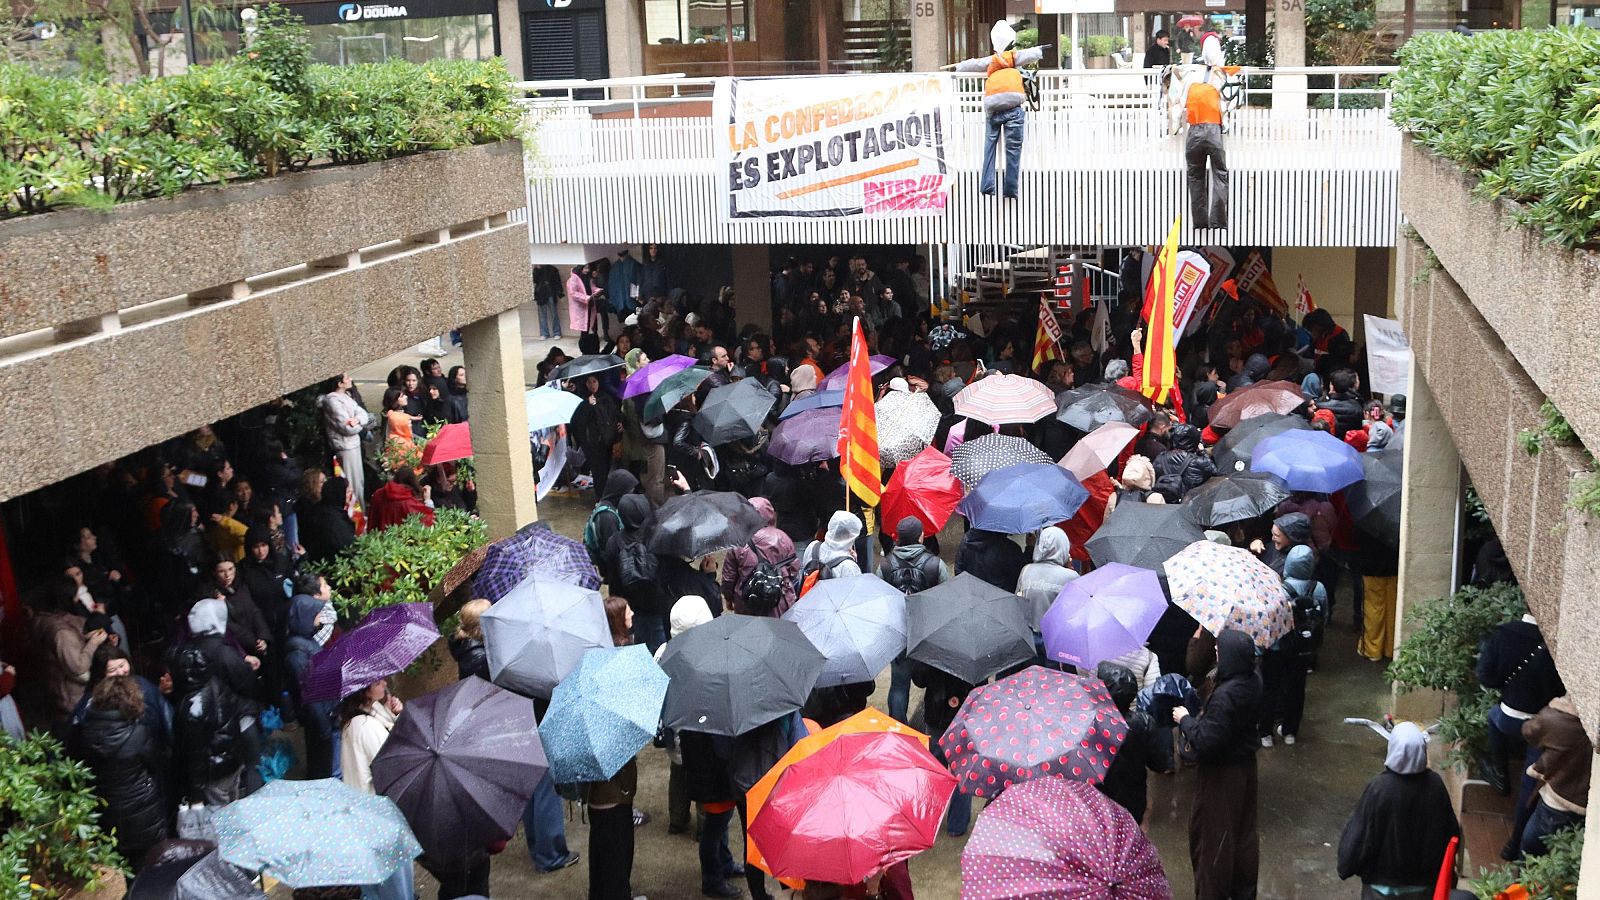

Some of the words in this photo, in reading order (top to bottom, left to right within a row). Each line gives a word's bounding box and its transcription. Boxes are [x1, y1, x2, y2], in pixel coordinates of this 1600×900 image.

[363, 6, 408, 18] DOUMA
[916, 2, 934, 17] 5B
[1282, 0, 1302, 11] 5A
[728, 121, 759, 152] LA
[729, 152, 761, 192] ÉS
